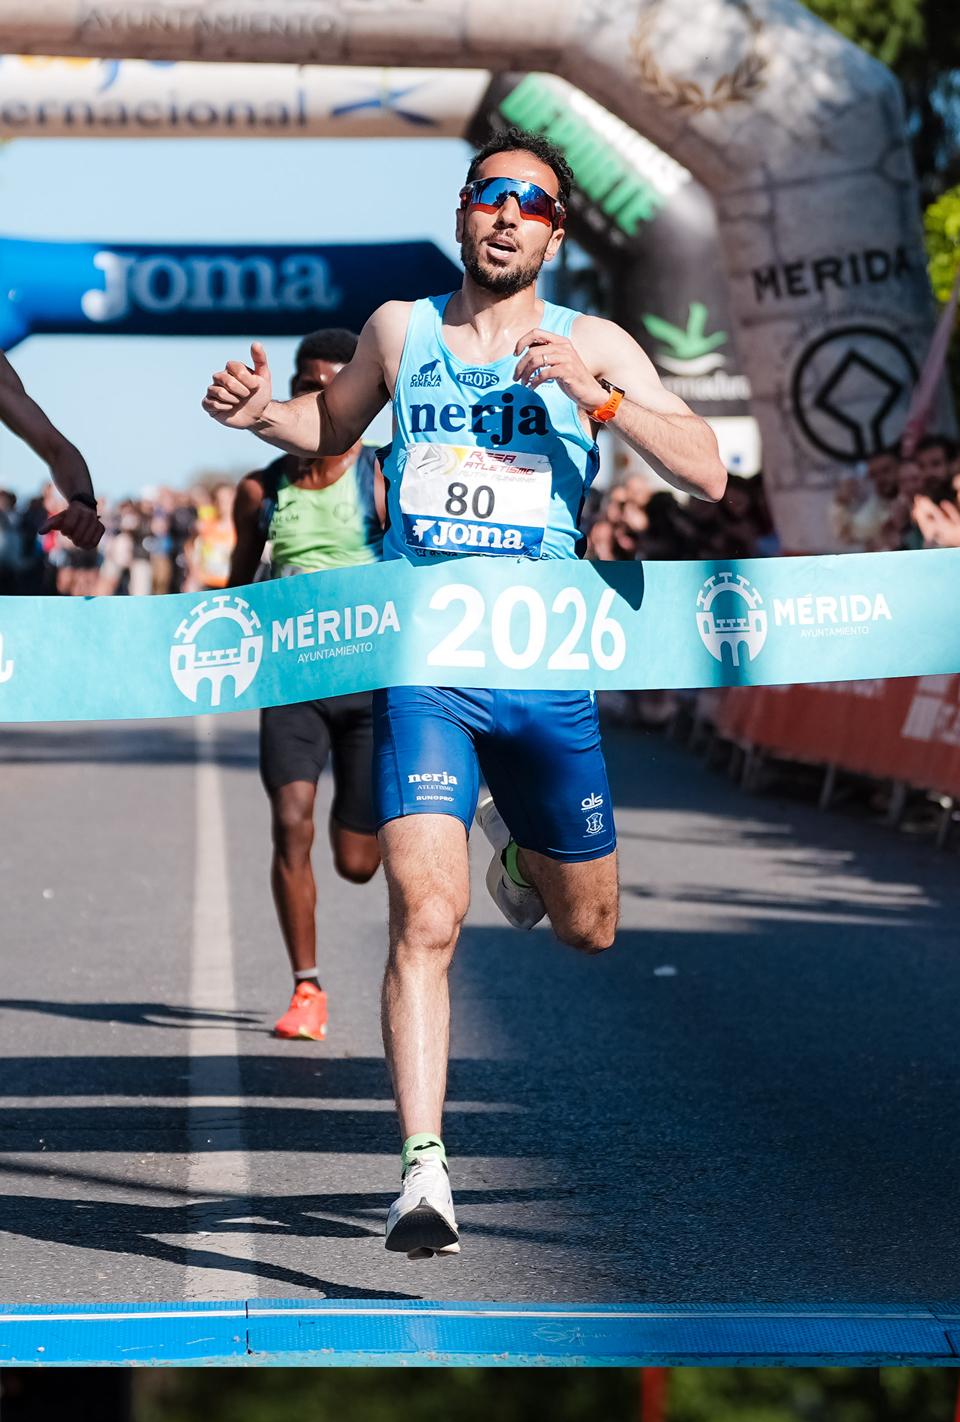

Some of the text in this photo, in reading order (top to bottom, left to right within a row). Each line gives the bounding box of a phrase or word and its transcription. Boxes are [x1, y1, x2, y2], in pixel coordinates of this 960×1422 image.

[81, 251, 342, 321] Joma
[458, 372, 498, 387] TROPS
[410, 393, 549, 445] nerja
[445, 482, 495, 519] 80
[432, 520, 524, 550] Joma
[772, 593, 893, 626] MÉRIDA
[271, 600, 400, 653] MÉRIDA
[427, 584, 626, 671] 2026
[800, 625, 869, 639] AYUNTAMIENTO
[297, 642, 373, 663] AYUNTAMIENTO
[408, 771, 458, 785] nerja
